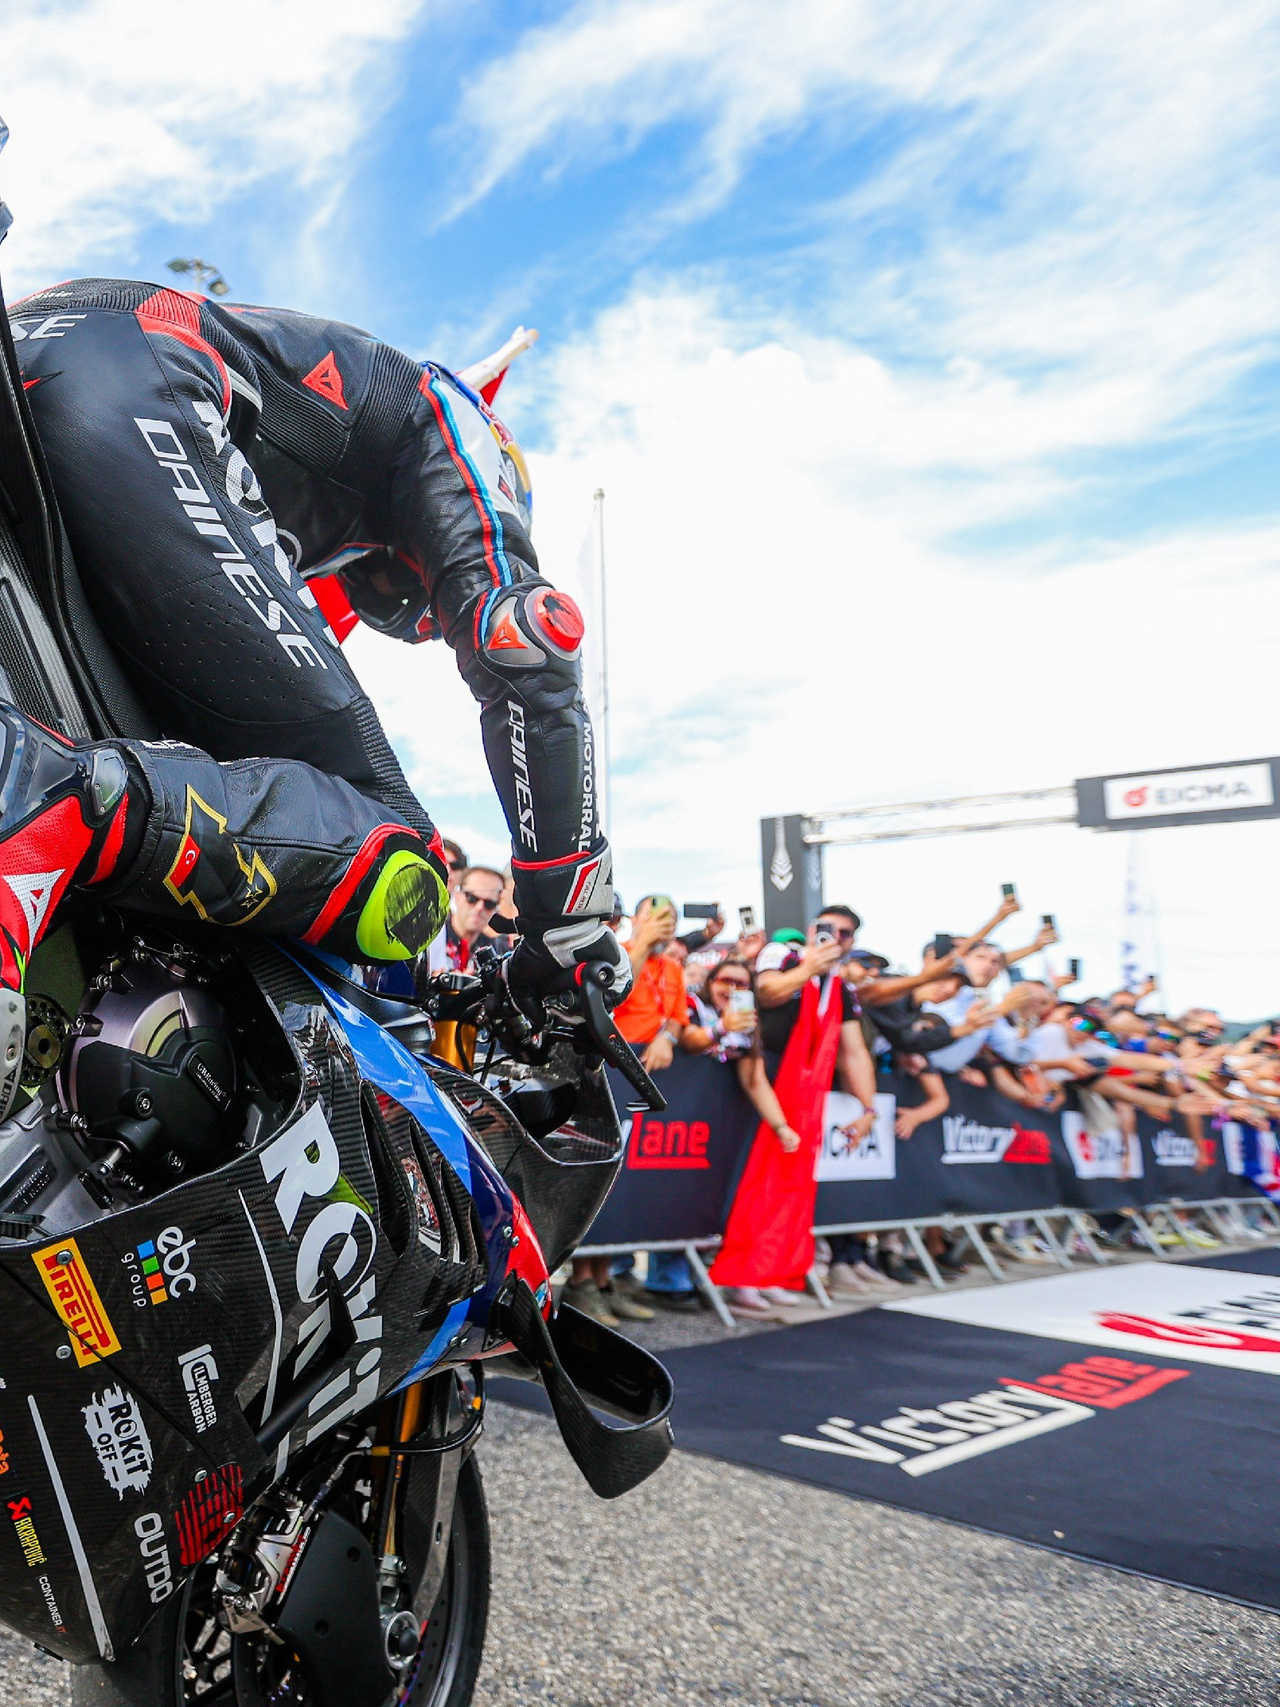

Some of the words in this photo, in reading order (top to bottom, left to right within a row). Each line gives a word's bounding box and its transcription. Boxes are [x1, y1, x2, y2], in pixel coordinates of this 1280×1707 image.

[134, 417, 329, 670] DAINESE
[507, 699, 539, 853] DAINESE
[1154, 780, 1252, 805] EICMA
[121, 1252, 147, 1307] group
[157, 1226, 197, 1298] ebc
[43, 1248, 111, 1357] PIRELLI
[193, 1365, 218, 1428] ILMBERGER
[96, 1432, 119, 1462] OFF
